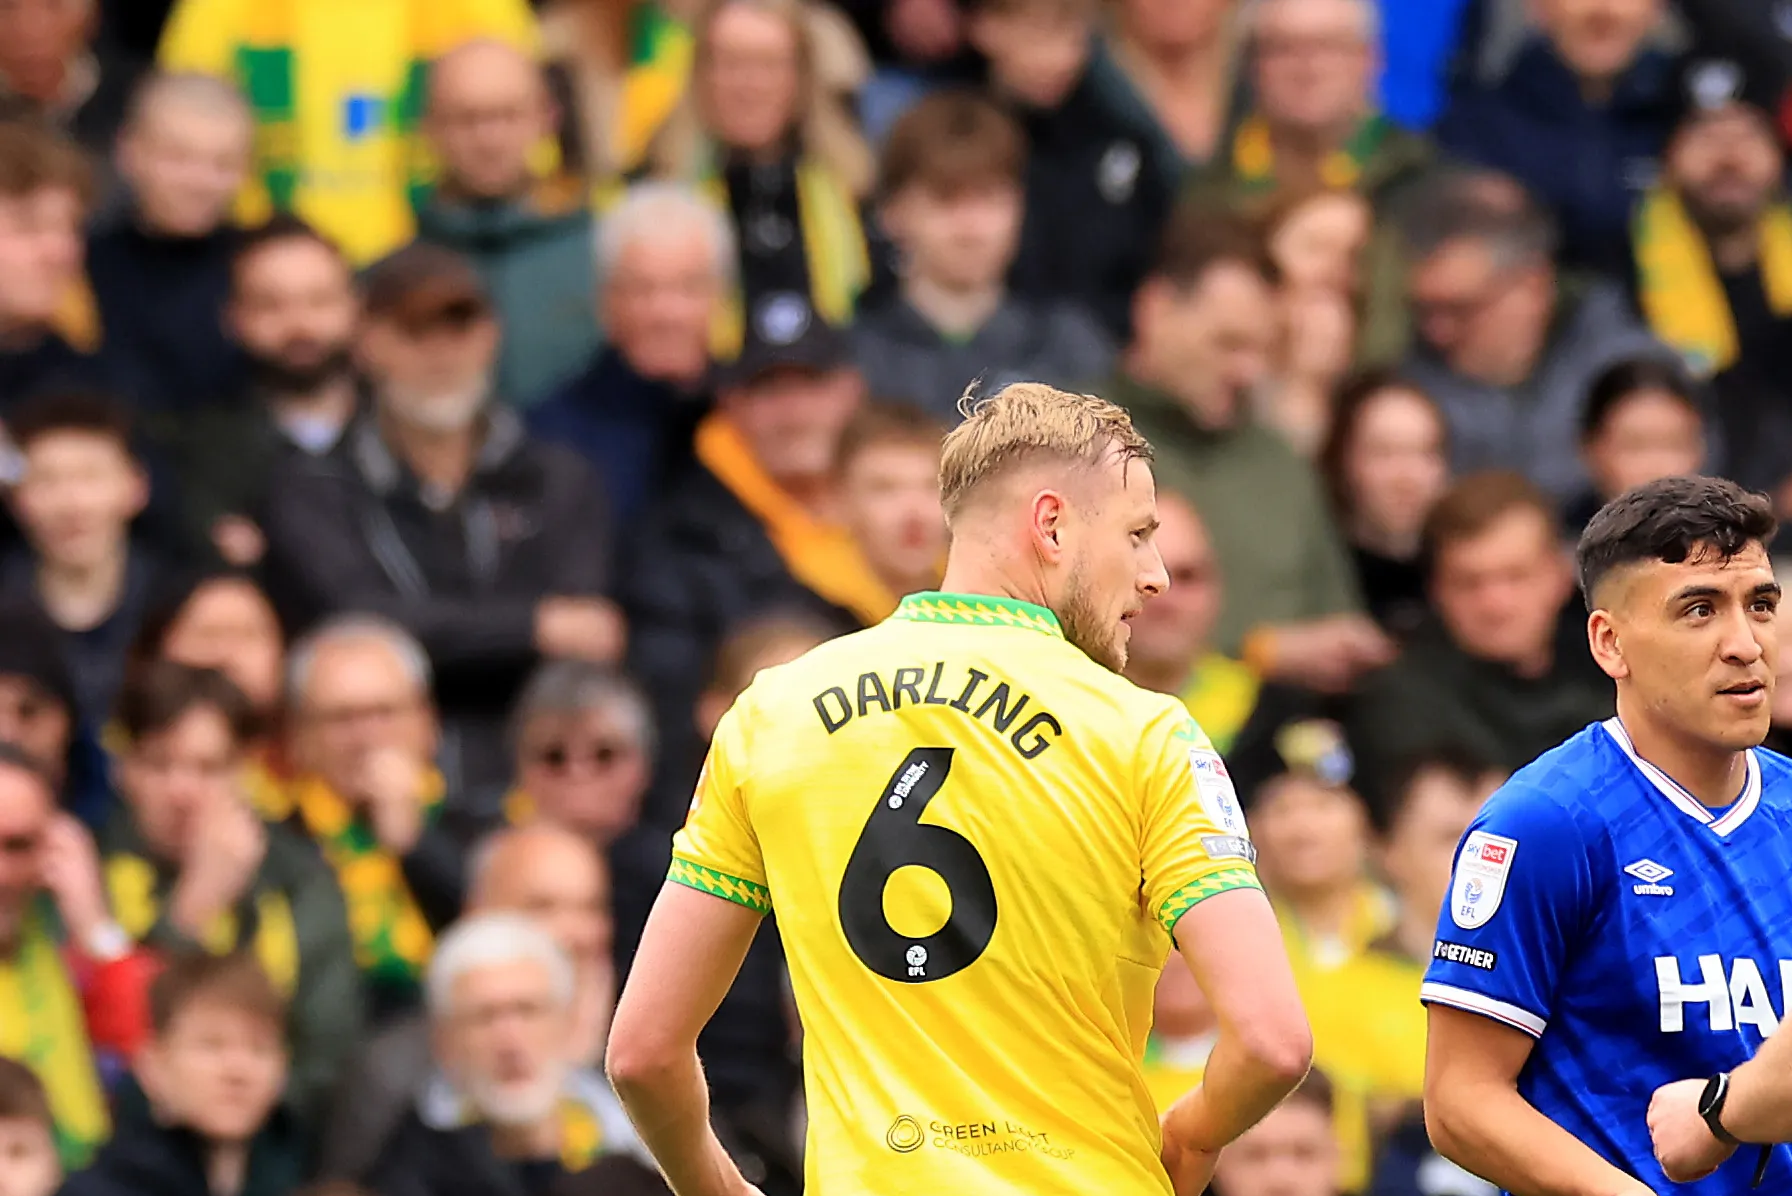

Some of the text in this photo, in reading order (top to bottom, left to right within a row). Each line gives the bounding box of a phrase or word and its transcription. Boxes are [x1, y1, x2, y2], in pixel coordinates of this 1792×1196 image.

[812, 661, 1062, 760] DARLING
[1483, 845, 1504, 861] bet
[838, 747, 998, 983] 6
[1461, 905, 1475, 919] EFL
[908, 966, 925, 976] EFL
